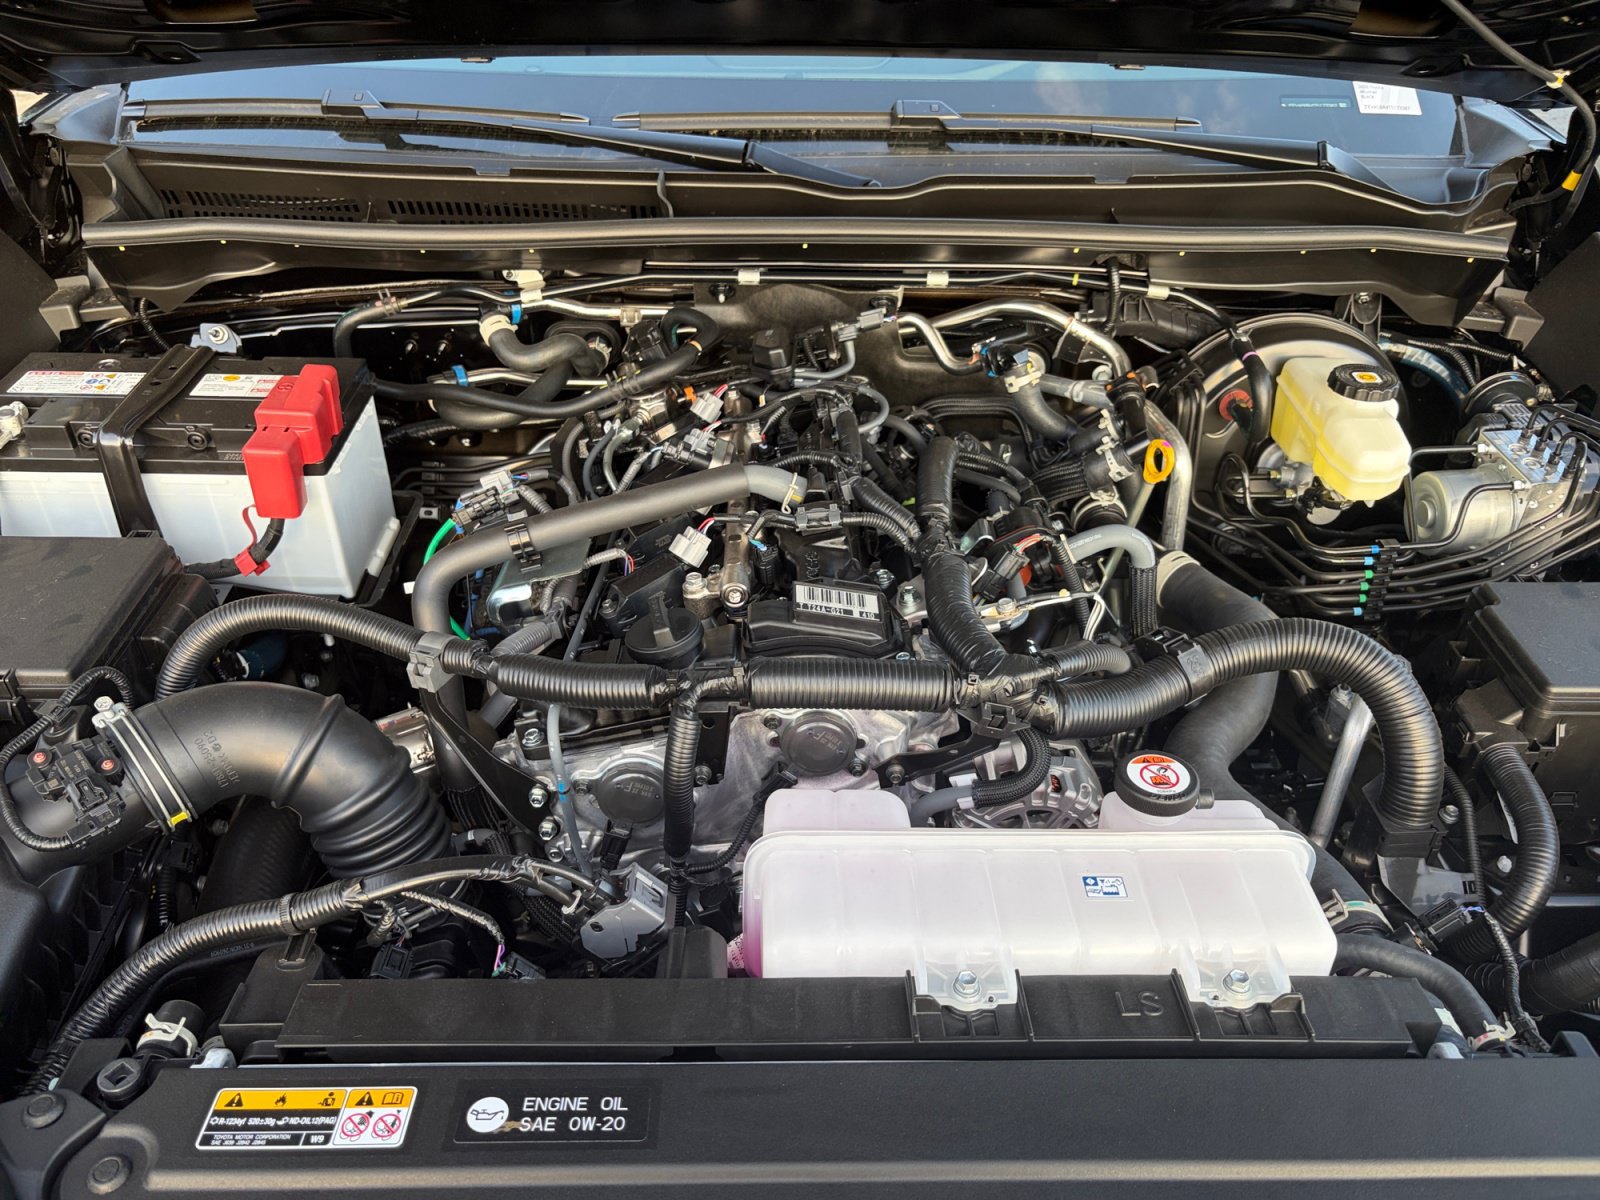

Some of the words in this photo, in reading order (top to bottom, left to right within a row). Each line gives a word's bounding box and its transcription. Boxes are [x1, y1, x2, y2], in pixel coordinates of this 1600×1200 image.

[1114, 991, 1164, 1016] LS
[522, 1096, 589, 1111] ENGINE
[600, 1096, 628, 1111] OIL
[519, 1116, 557, 1131] SAE
[568, 1116, 626, 1131] 0W-20
[310, 1135, 324, 1144] W9
